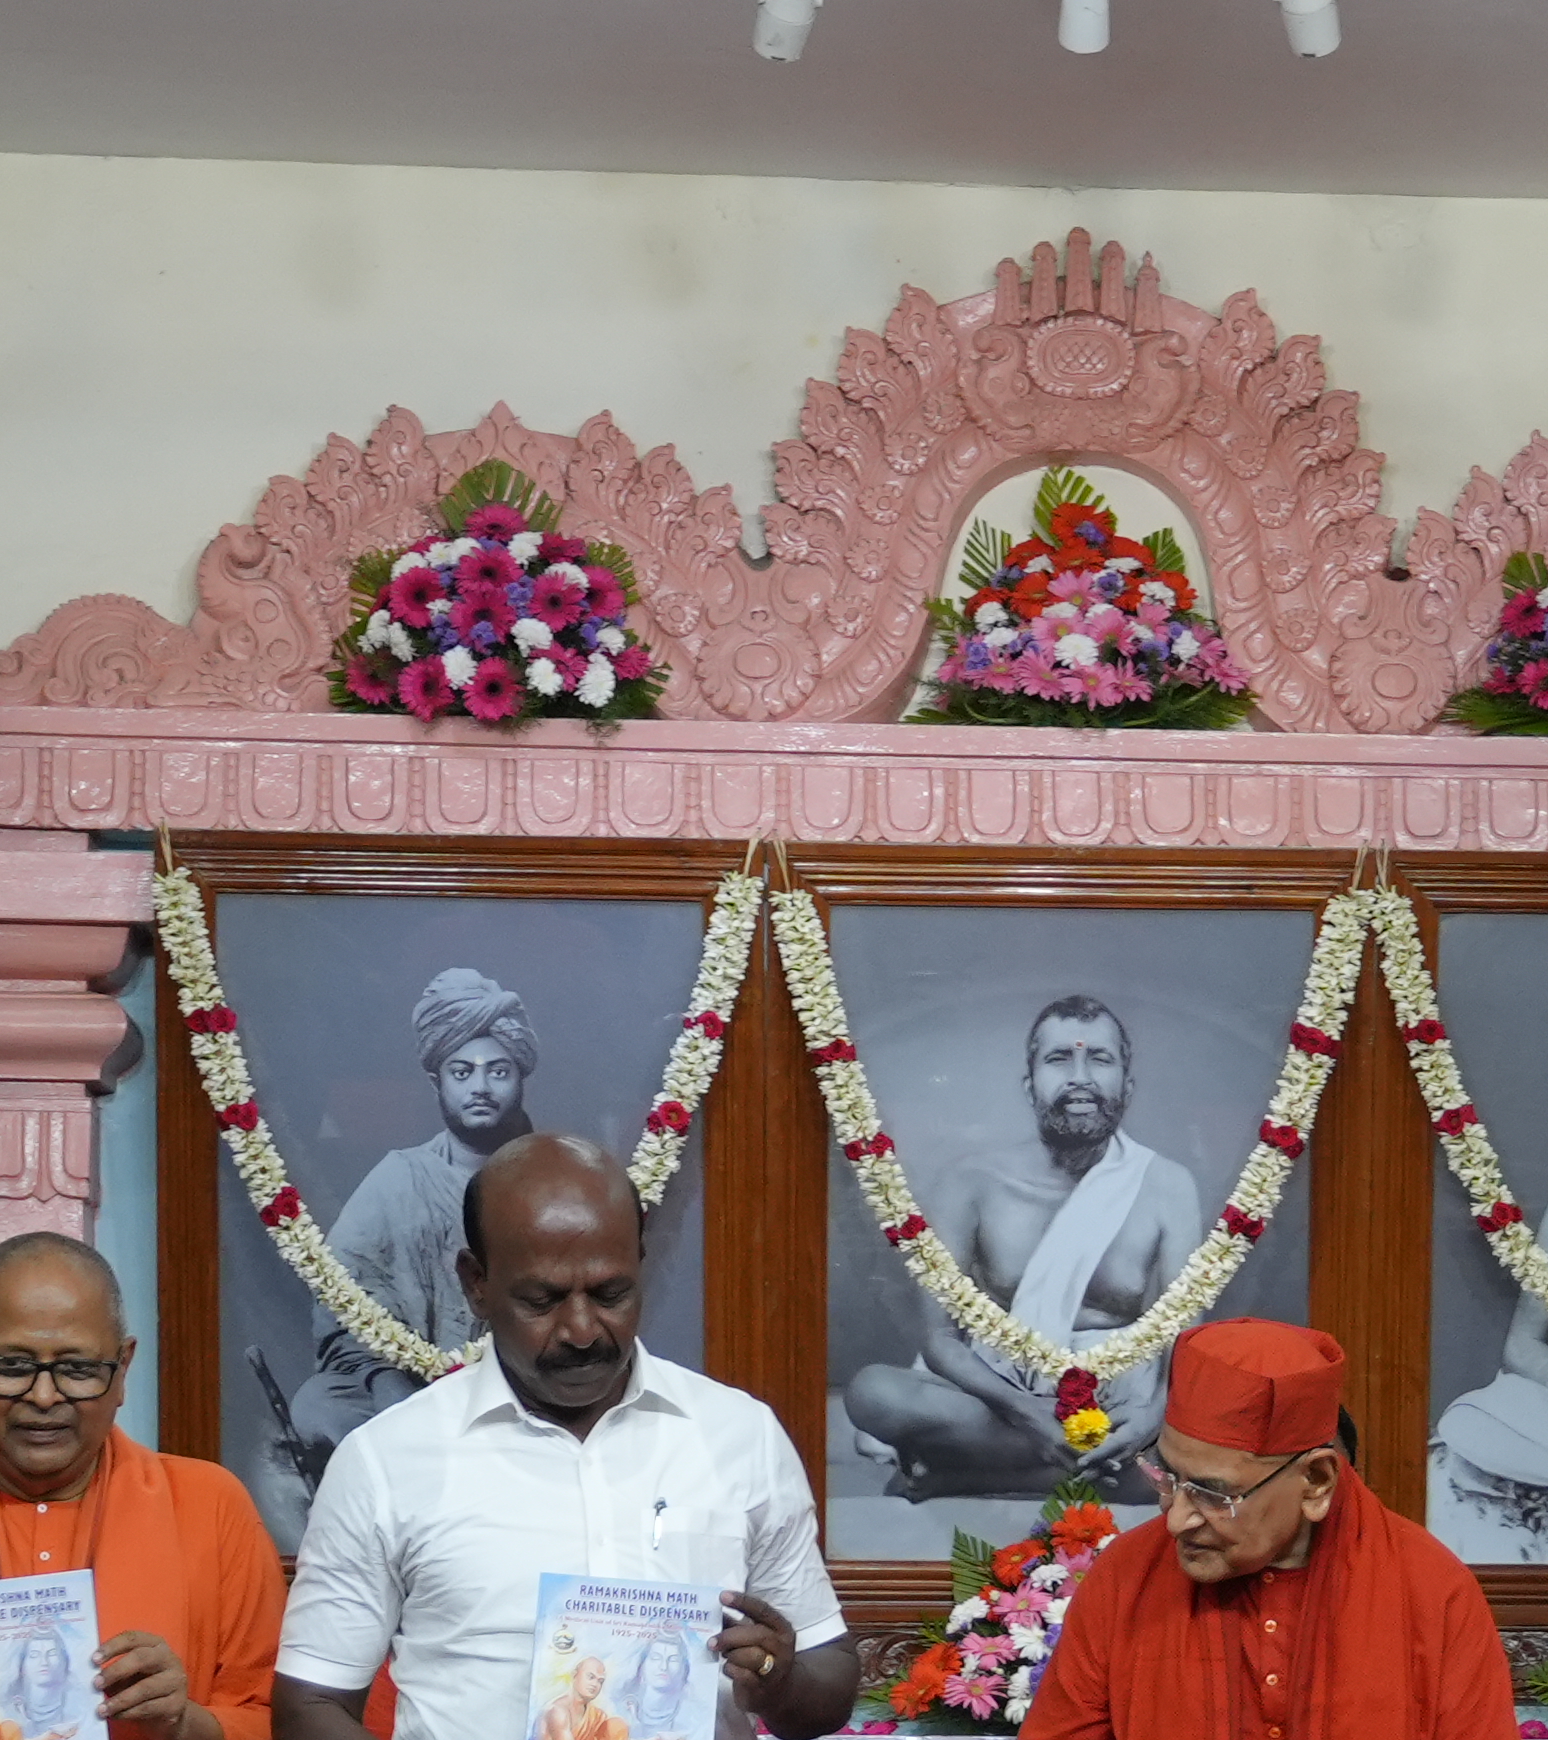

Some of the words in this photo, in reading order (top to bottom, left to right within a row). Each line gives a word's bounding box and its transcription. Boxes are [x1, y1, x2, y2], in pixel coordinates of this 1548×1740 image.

[34, 1586, 67, 1599] MATH
[579, 1584, 662, 1602] RAMAKRISHNA
[666, 1591, 698, 1604] MATH
[10, 1601, 81, 1619] DISPENSARY
[565, 1599, 635, 1616] CHARITABLE
[640, 1605, 710, 1621] DISPENSARY
